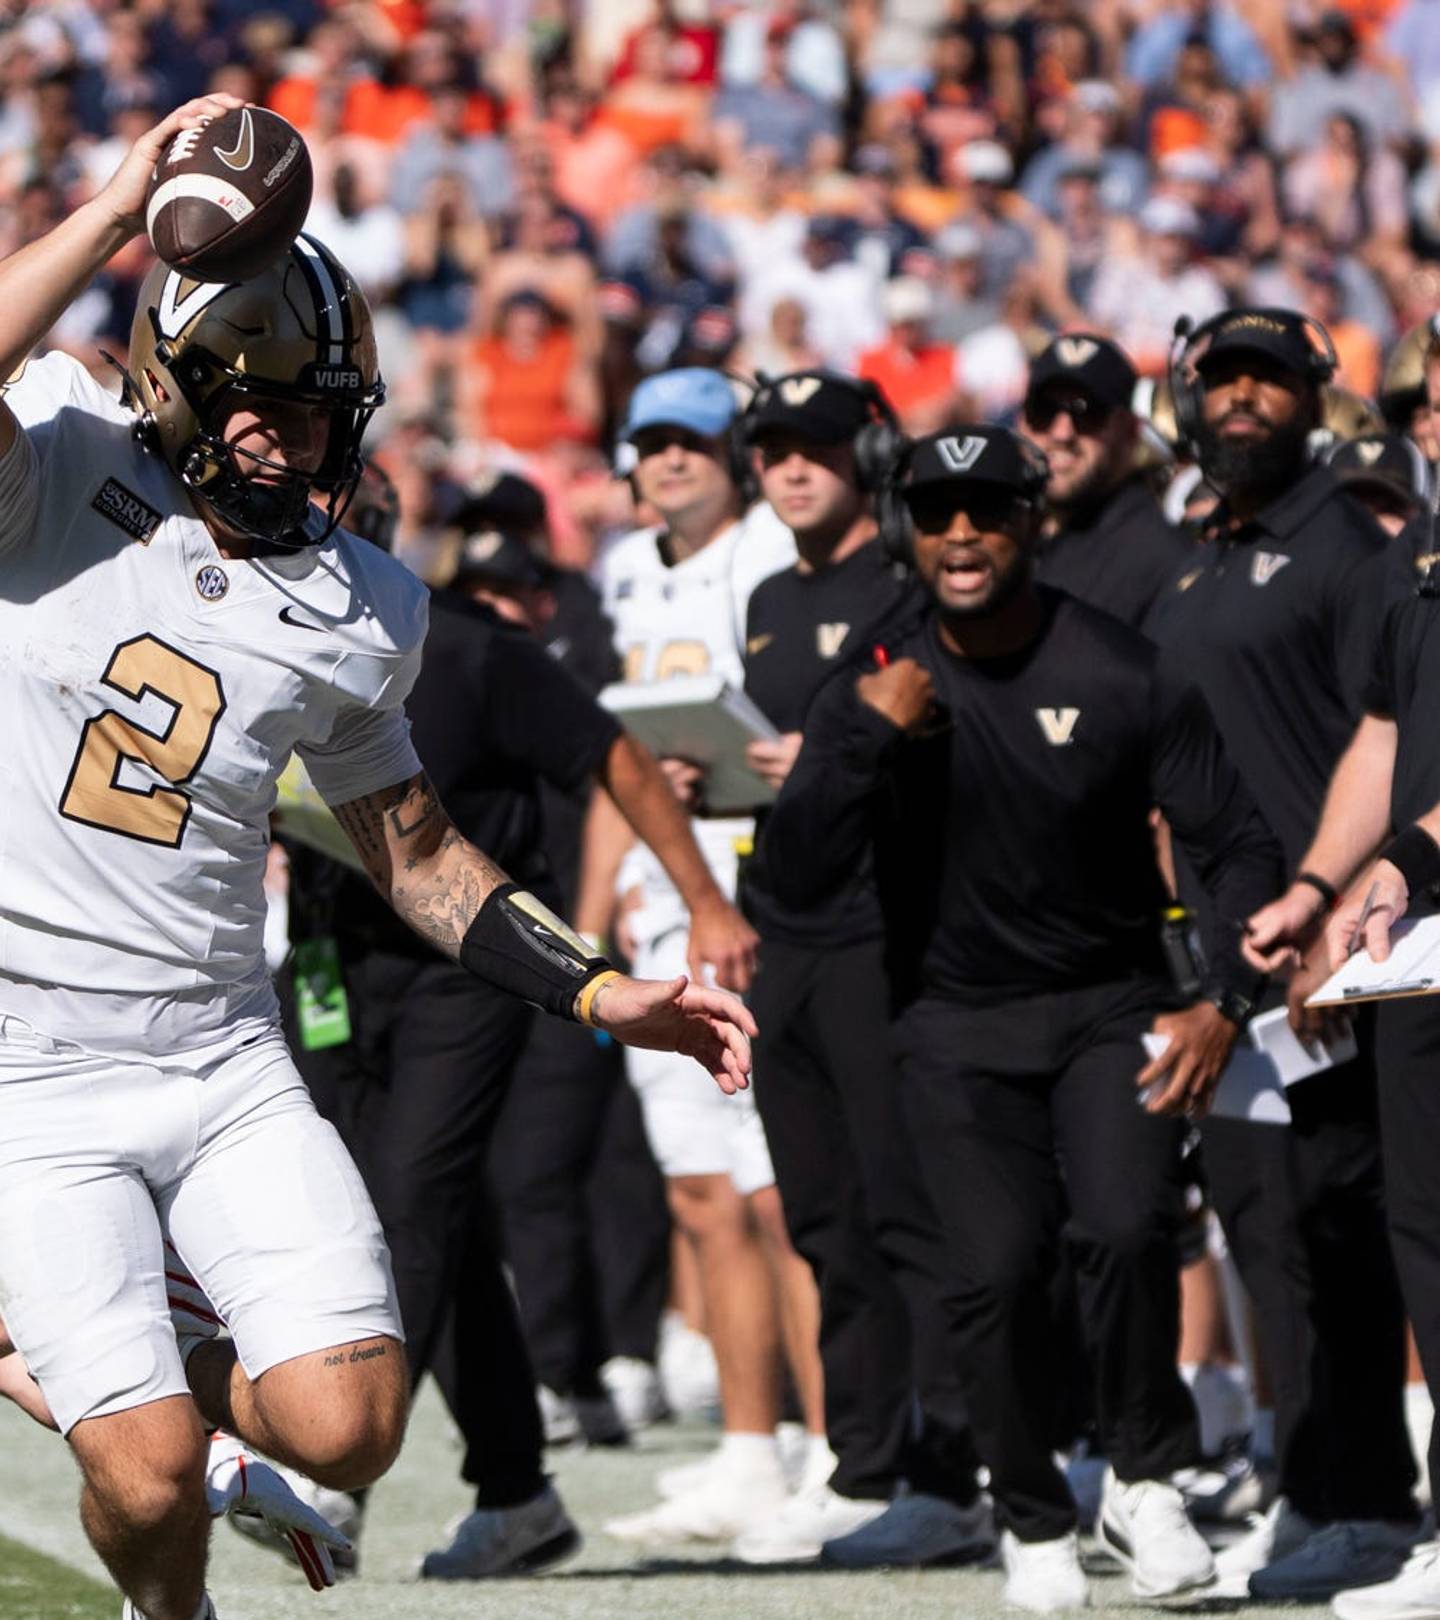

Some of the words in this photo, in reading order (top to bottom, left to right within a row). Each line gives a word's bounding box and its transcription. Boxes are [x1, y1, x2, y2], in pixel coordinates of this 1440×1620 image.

[314, 370, 361, 389] VUFB
[935, 435, 989, 473] V
[109, 490, 158, 531] SRM
[1250, 550, 1291, 586] V
[59, 632, 228, 850] 2
[1035, 706, 1081, 745] V
